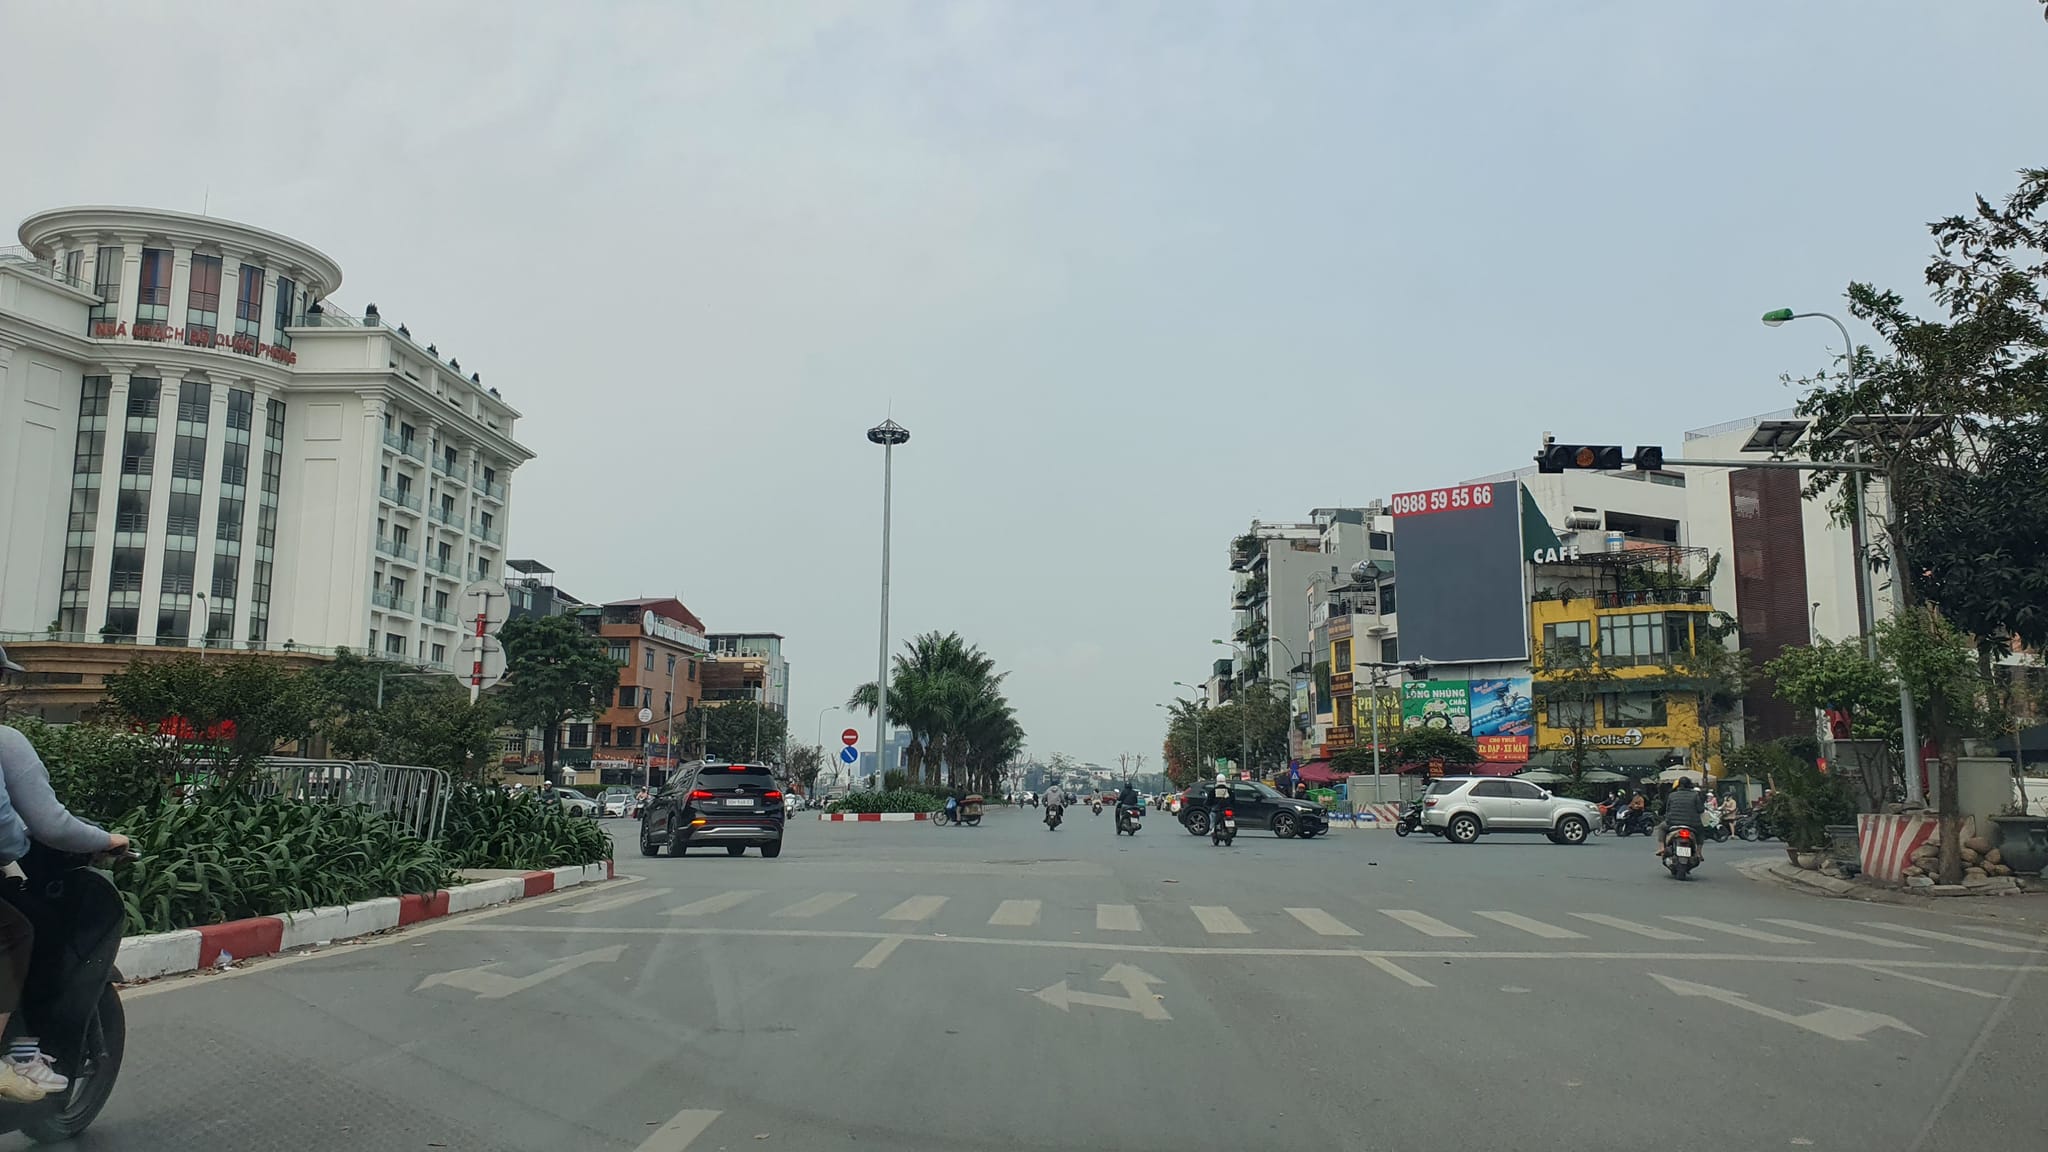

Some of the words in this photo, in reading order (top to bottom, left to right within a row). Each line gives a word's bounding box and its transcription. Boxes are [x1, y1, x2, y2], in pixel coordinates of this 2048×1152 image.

[1393, 493, 1427, 514] 0988
[1430, 490, 1448, 510] 59
[1451, 487, 1469, 507] 55
[1473, 485, 1491, 505] 66
